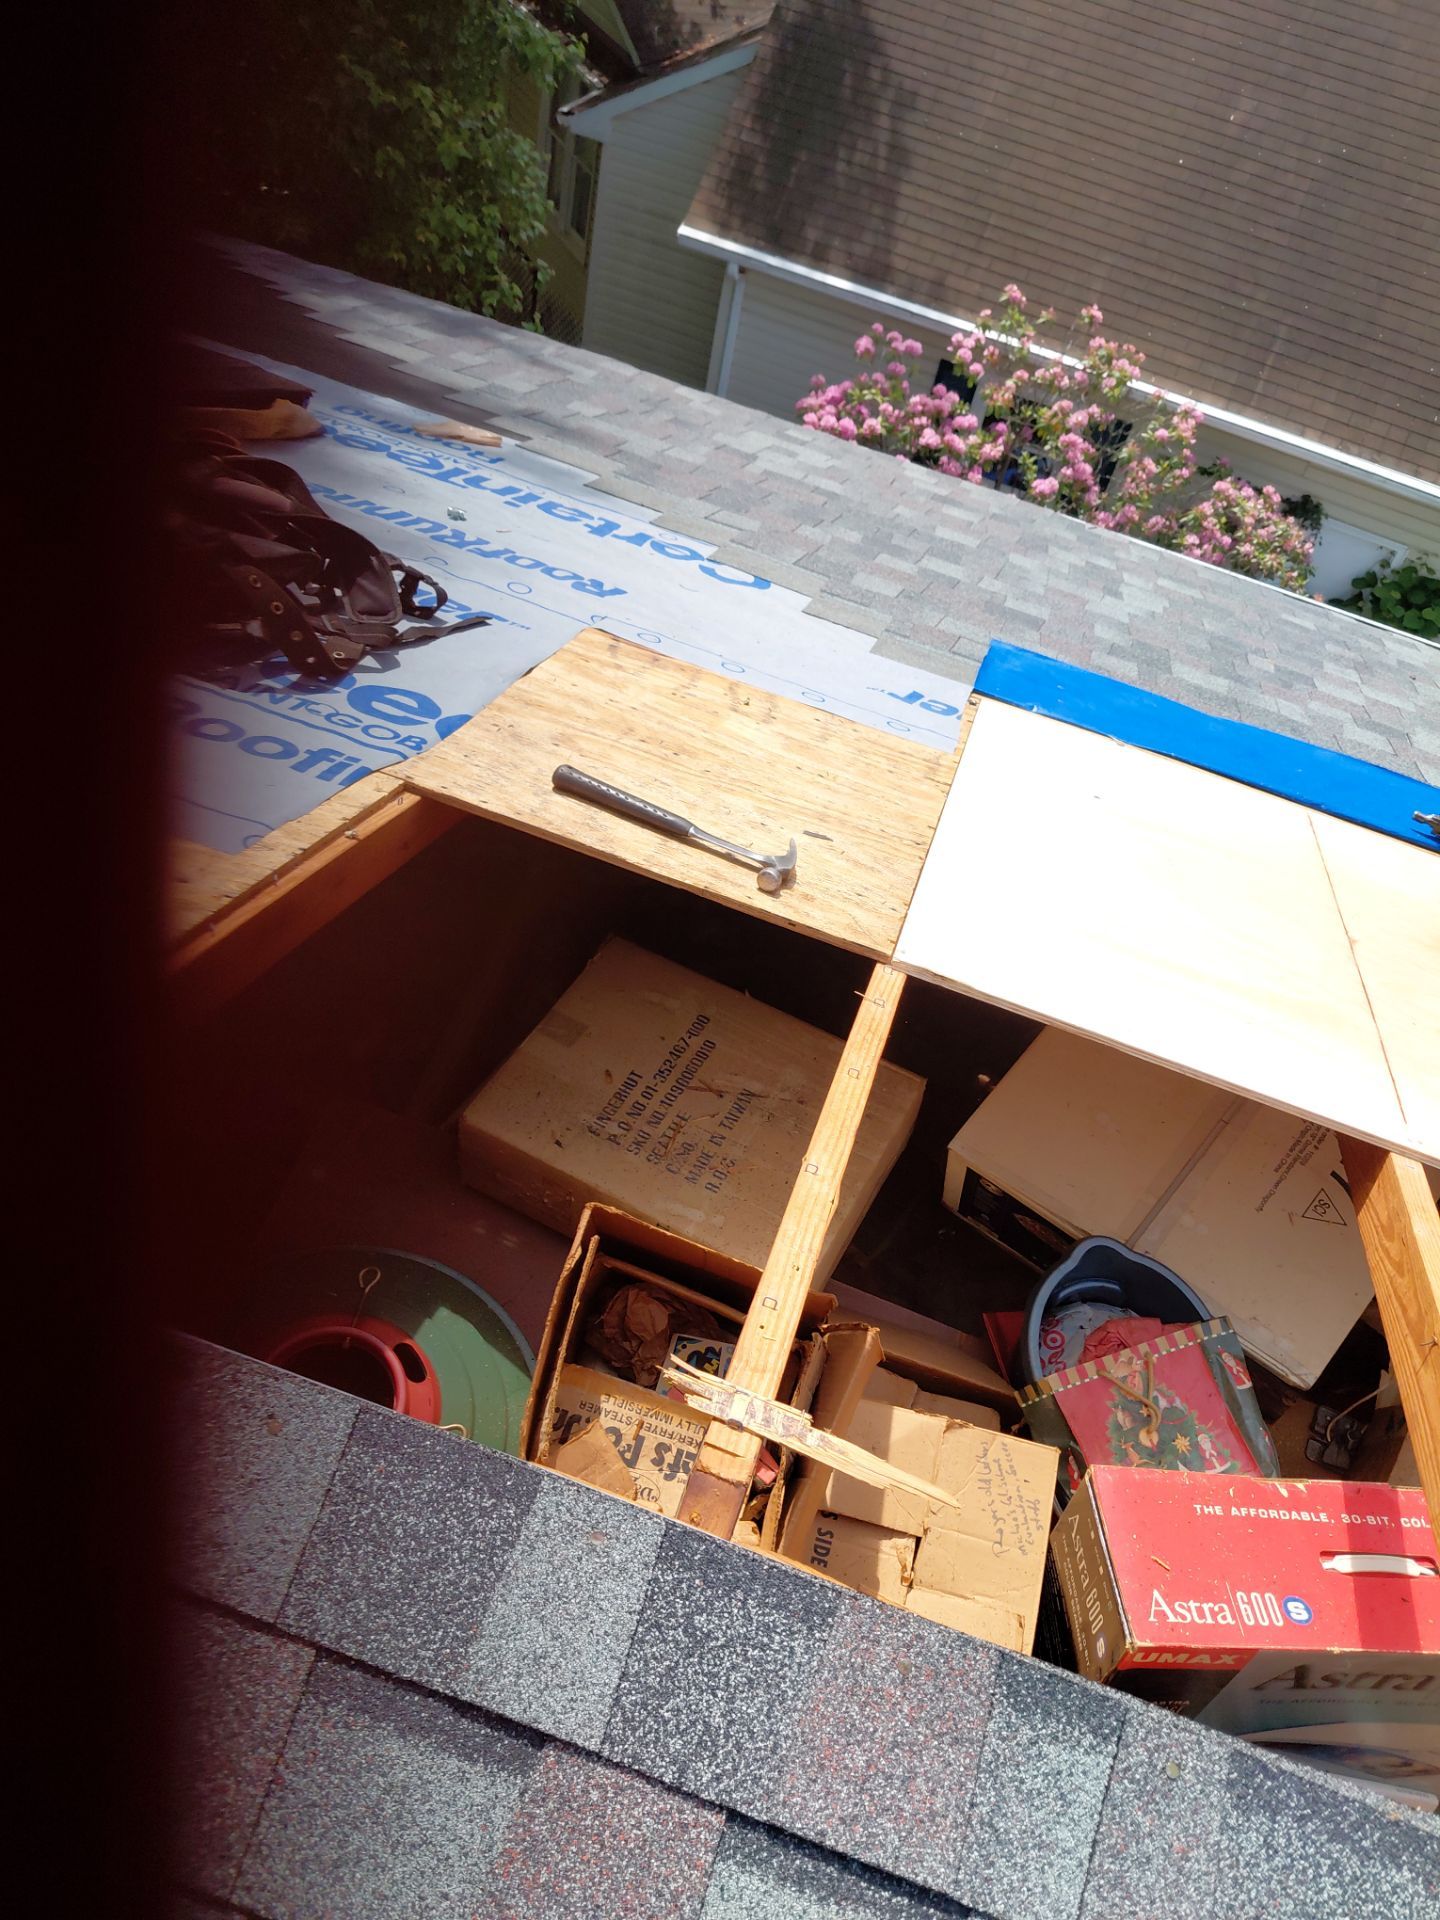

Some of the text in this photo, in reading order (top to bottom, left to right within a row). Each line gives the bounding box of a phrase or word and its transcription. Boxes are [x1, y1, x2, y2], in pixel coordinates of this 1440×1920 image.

[320, 424, 772, 590] CertainTee
[587, 1069, 644, 1137] FINGERHUT
[626, 1132, 652, 1156] SKU
[684, 1088, 754, 1185] MADE IN TAIWAN
[1311, 1199, 1331, 1218] SCI
[675, 1418, 708, 1435] ULLY
[1193, 1504, 1224, 1517] THE
[1230, 1506, 1335, 1525] AFFORDABLE,
[1341, 1513, 1396, 1528] 30-BIT,
[810, 1527, 835, 1569] SIDE
[1067, 1513, 1090, 1590] Astra
[1086, 1587, 1104, 1635] 600
[1148, 1589, 1236, 1625] Astra
[1236, 1591, 1284, 1627] 600
[1132, 1652, 1240, 1665] UMAX
[1252, 1664, 1435, 1692] Astra
